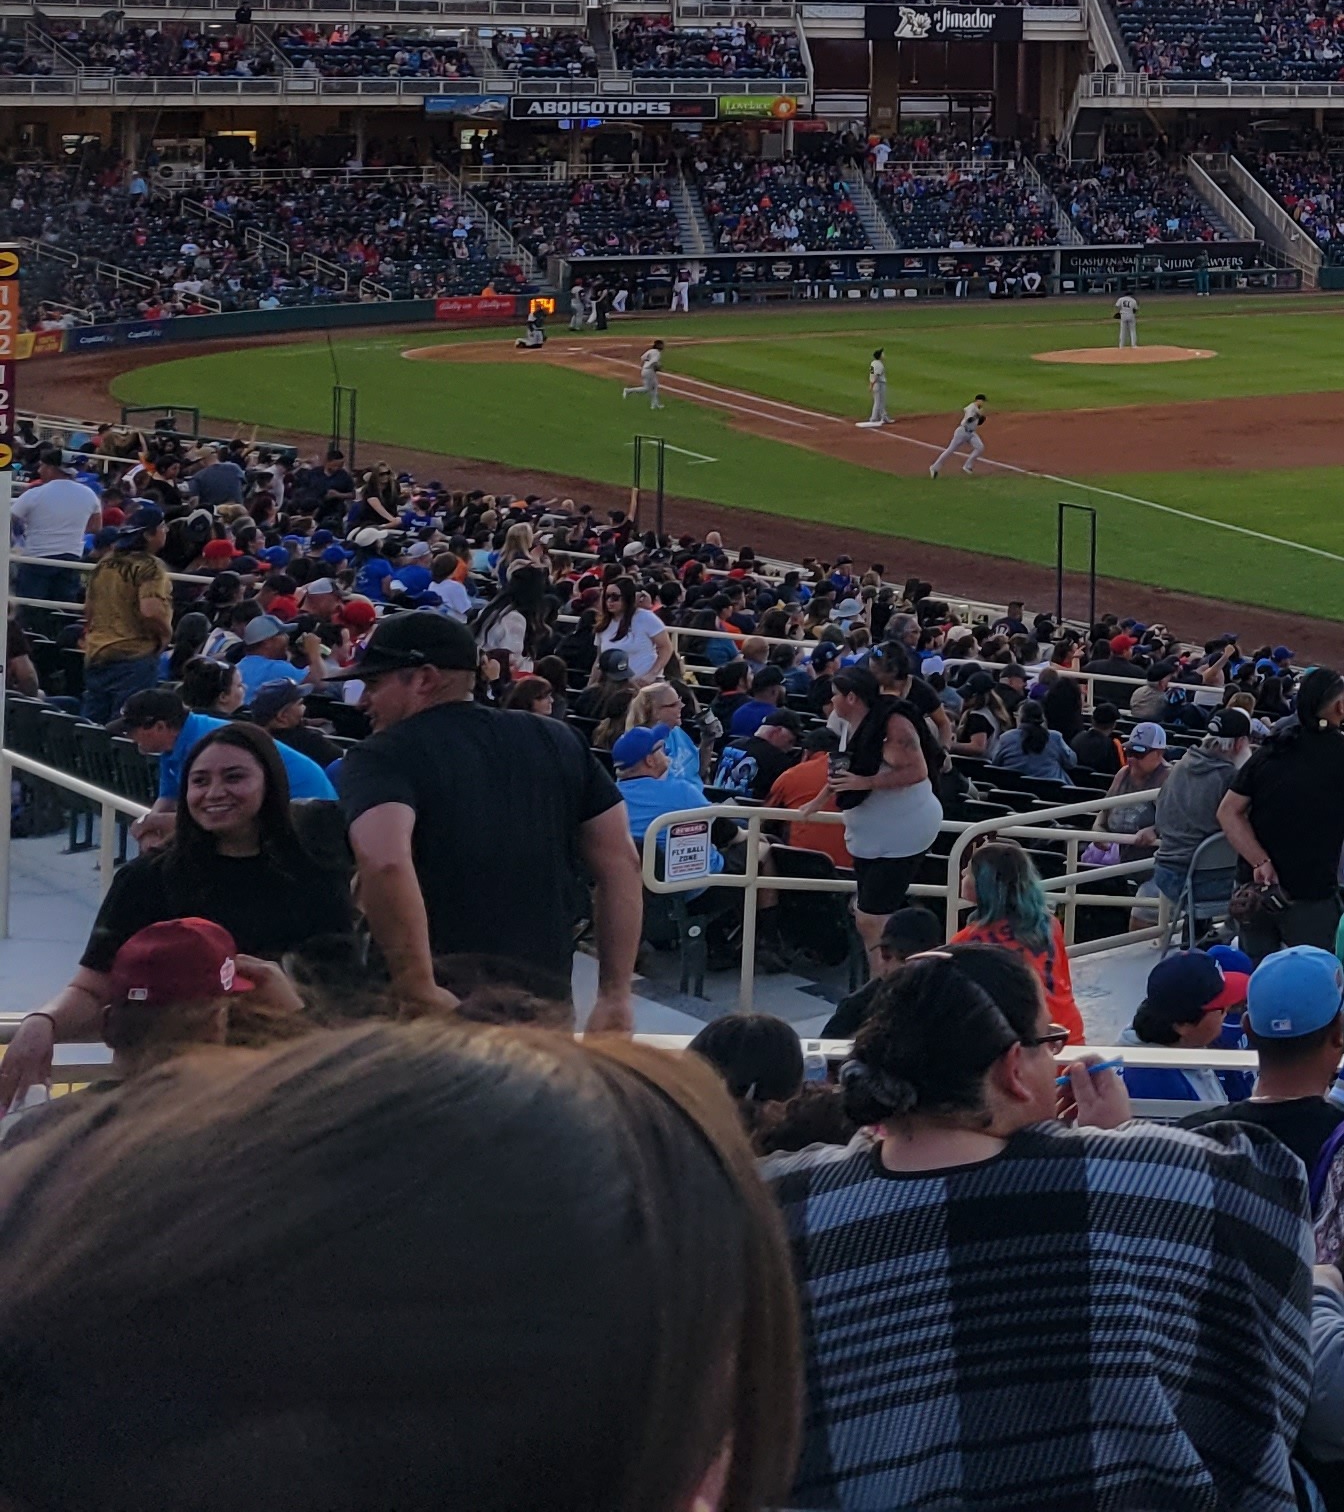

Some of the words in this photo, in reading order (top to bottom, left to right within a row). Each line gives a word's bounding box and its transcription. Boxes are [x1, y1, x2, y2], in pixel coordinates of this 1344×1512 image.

[936, 6, 997, 33] Jimador
[671, 848, 685, 856] FLY
[687, 845, 705, 854] BALL
[679, 853, 697, 862] ZONE
